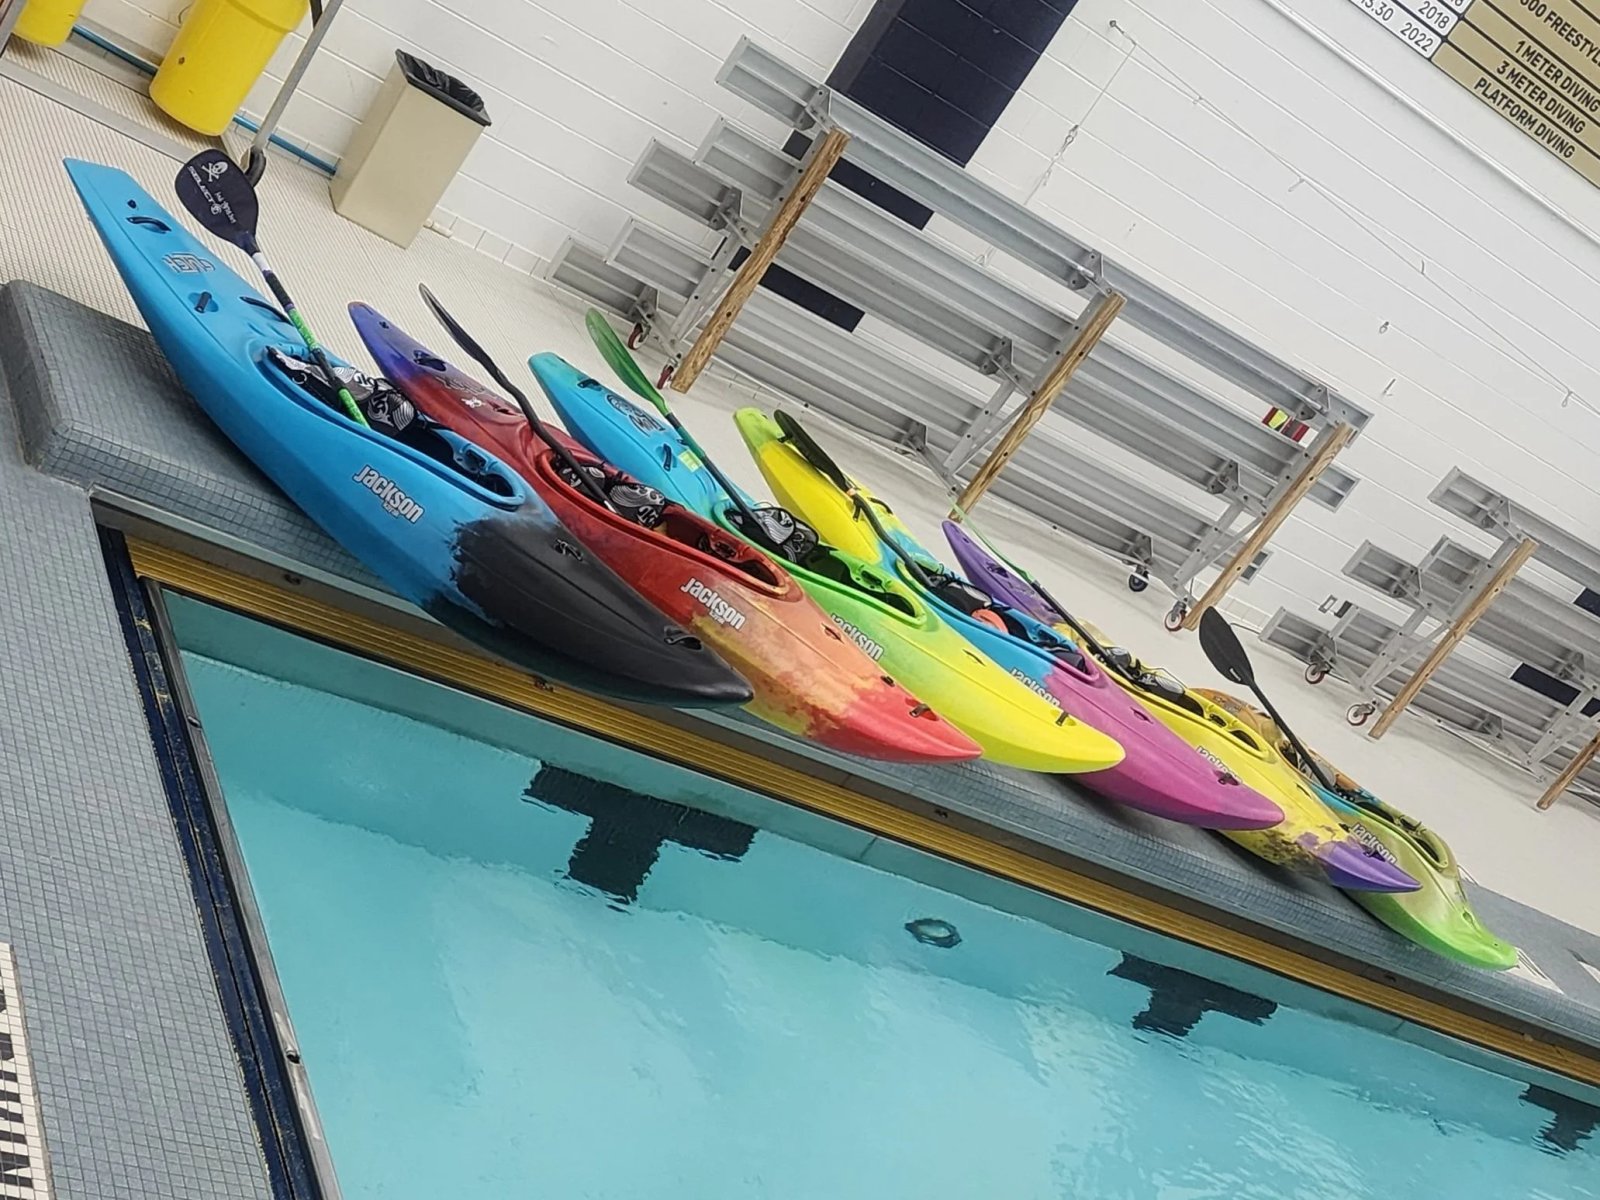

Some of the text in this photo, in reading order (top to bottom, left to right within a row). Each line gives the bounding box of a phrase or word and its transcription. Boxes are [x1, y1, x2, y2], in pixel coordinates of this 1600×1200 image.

[1400, 22, 1434, 52] 2022
[1418, 1, 1450, 29] 2018
[1543, 10, 1600, 67] FREESTYL
[1496, 60, 1586, 134] 3 METER DIVING
[1515, 40, 1600, 112] 1 METER DIVING
[1474, 77, 1575, 159] PLATFORM DIVING
